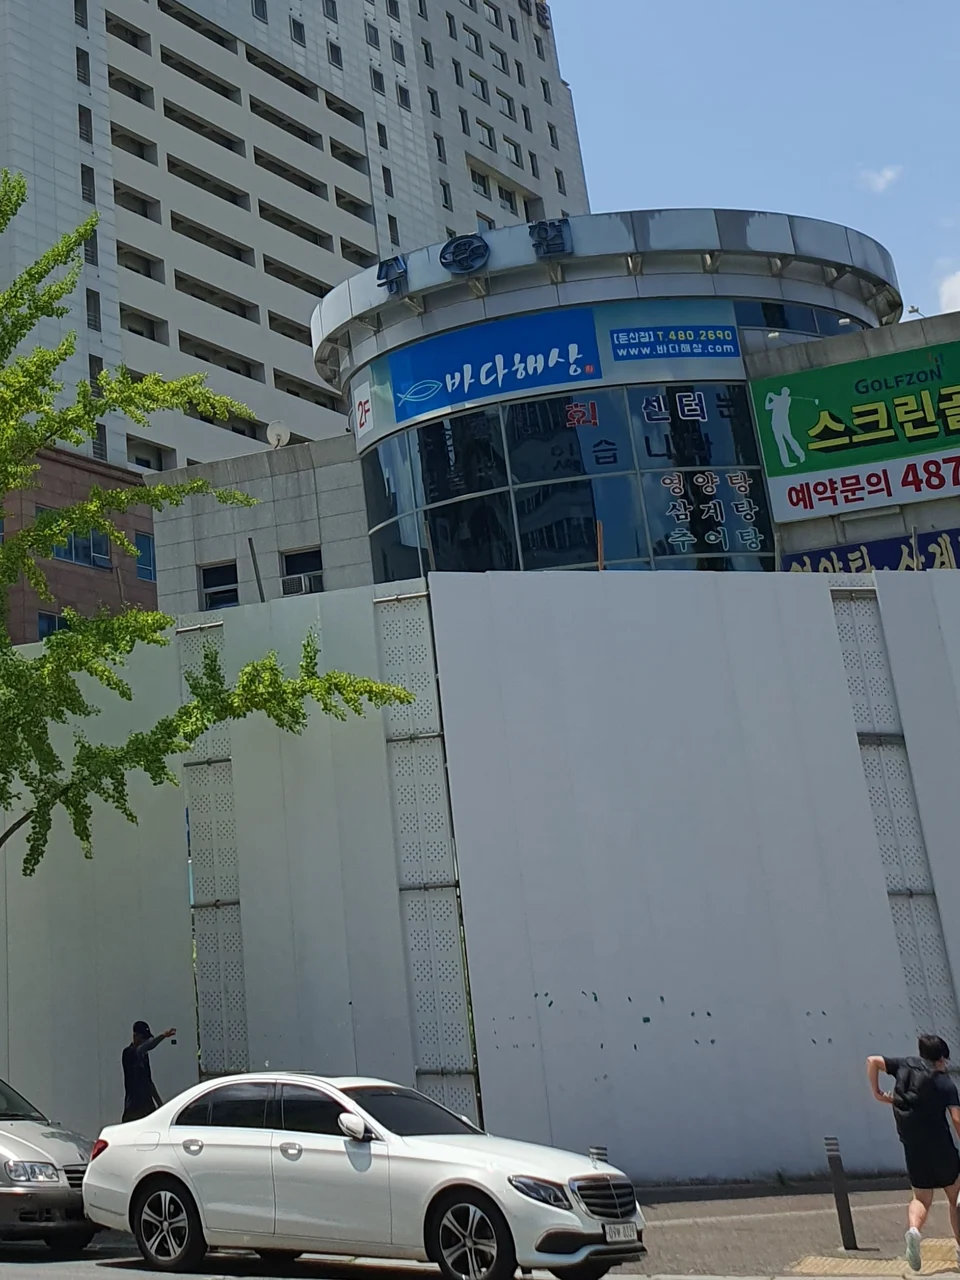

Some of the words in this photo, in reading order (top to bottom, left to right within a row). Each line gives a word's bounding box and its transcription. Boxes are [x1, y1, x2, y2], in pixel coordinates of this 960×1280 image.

[613, 330, 654, 345] [둔산점]
[656, 329, 733, 342] T.480.2690
[616, 343, 735, 357] www.바다해상.com
[444, 343, 583, 394] 바다해상
[854, 367, 944, 395] GOLFZON
[357, 399, 371, 429] 2F
[660, 470, 754, 496] 영양탕
[787, 468, 893, 511] 예약문의
[665, 497, 760, 523] 삼계탕
[667, 525, 765, 553] 추어탕
